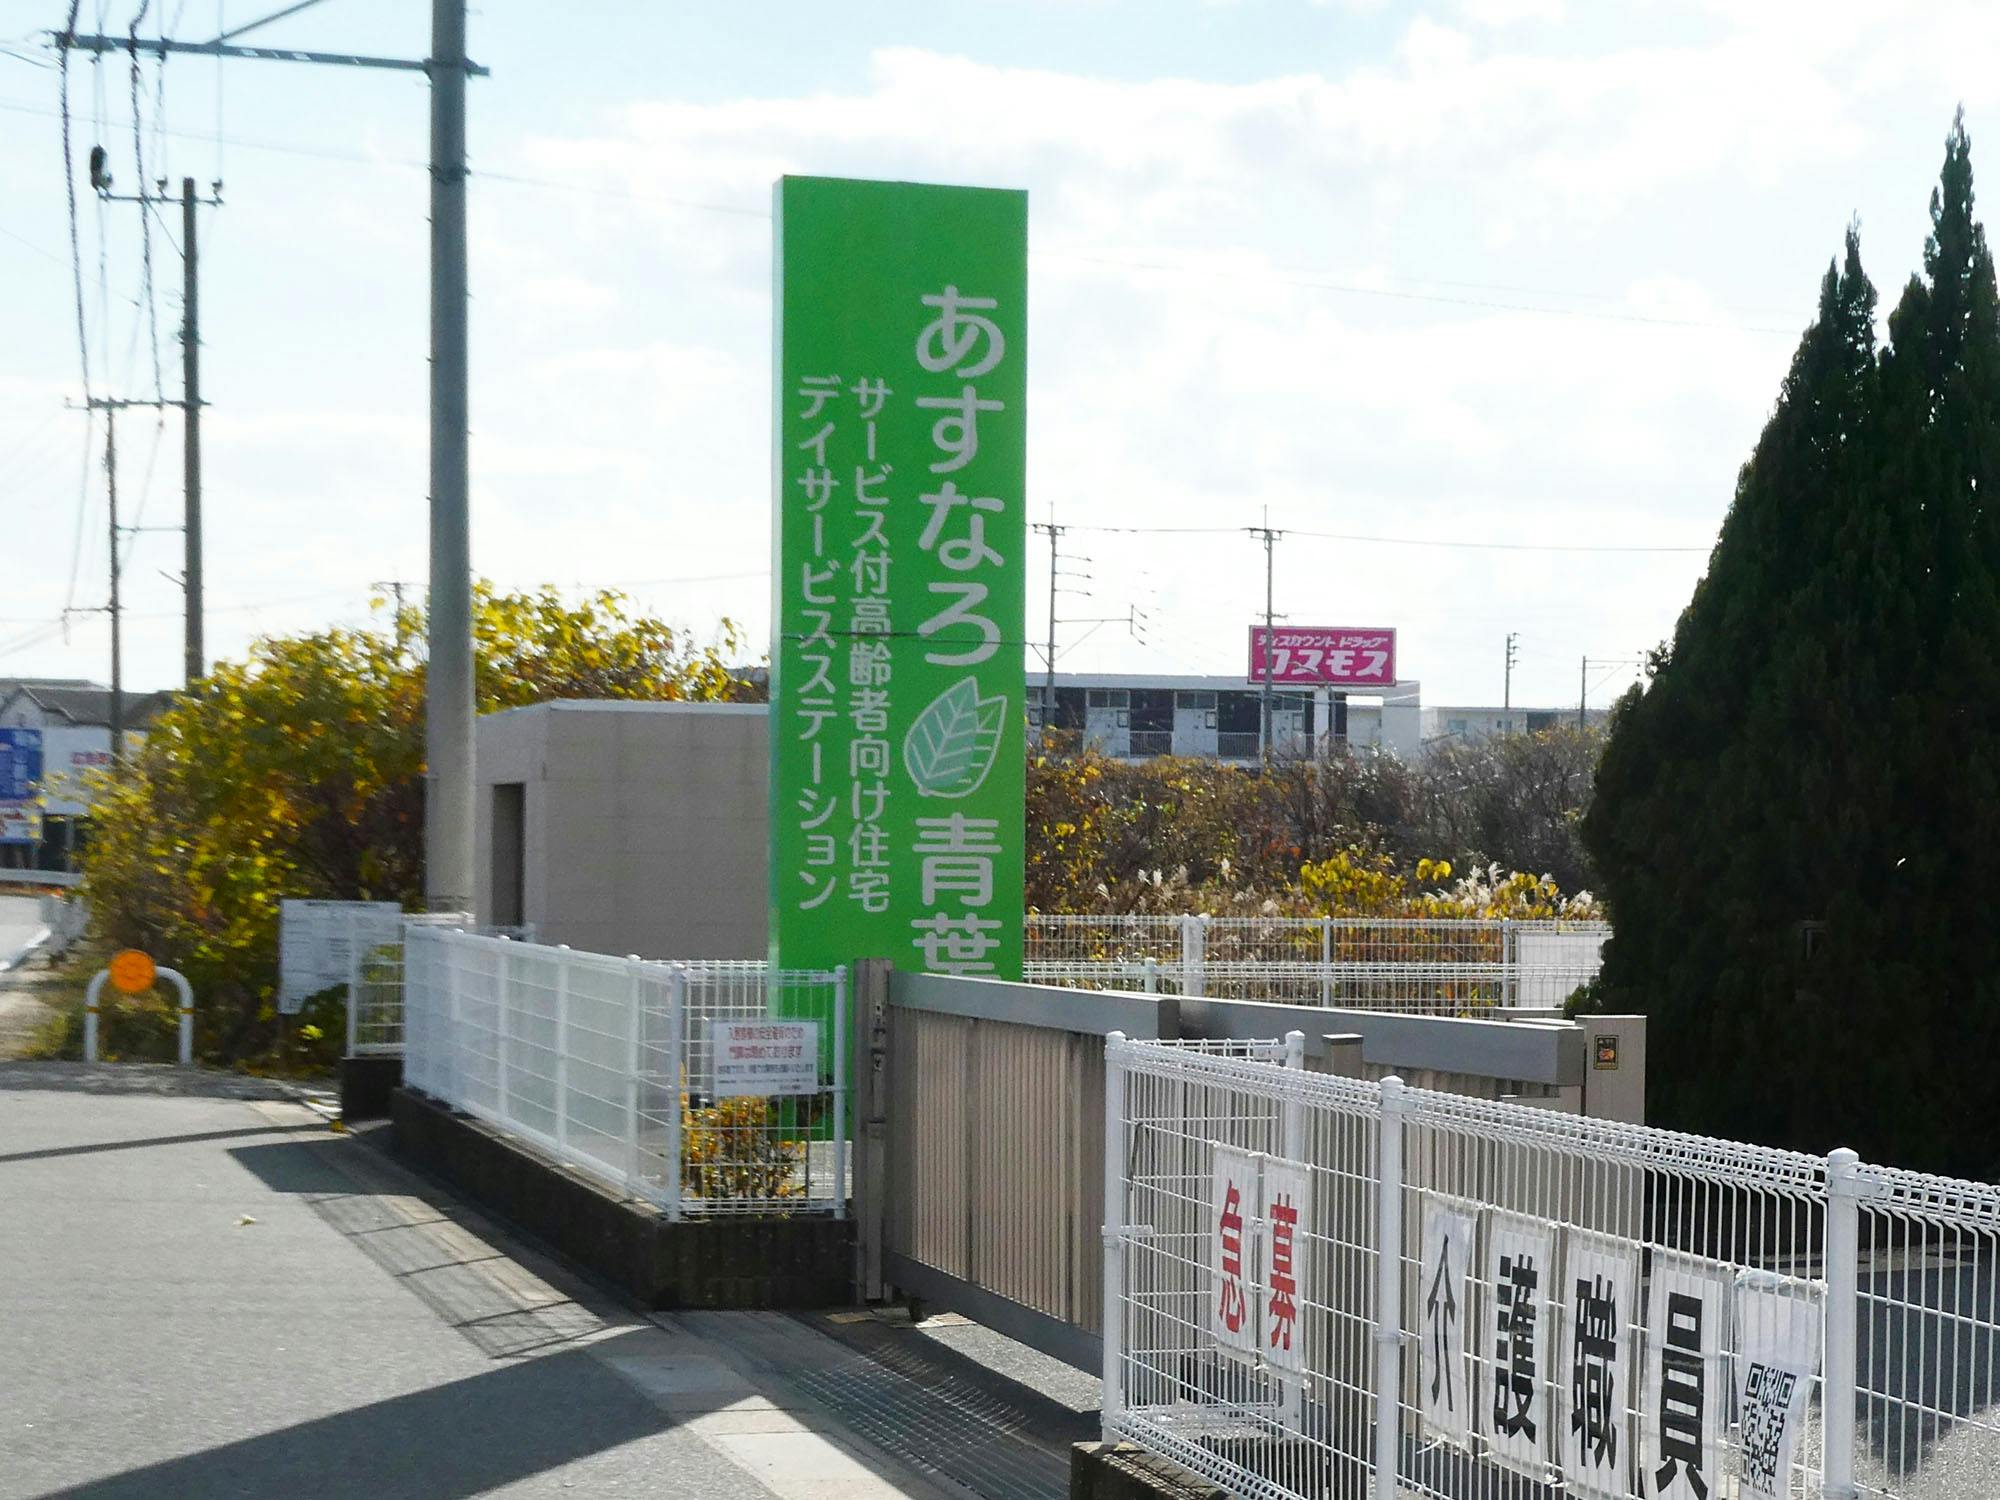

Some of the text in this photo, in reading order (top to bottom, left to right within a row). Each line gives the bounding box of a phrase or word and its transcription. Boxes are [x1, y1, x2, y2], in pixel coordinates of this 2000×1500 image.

[796, 373, 842, 911] デイサービスステーション
[847, 376, 894, 913] サービス付高齢者向け住宅
[915, 284, 1006, 666] あすなろ
[1257, 649, 1389, 678] コスモス
[1338, 635, 1389, 648] ドラッグ
